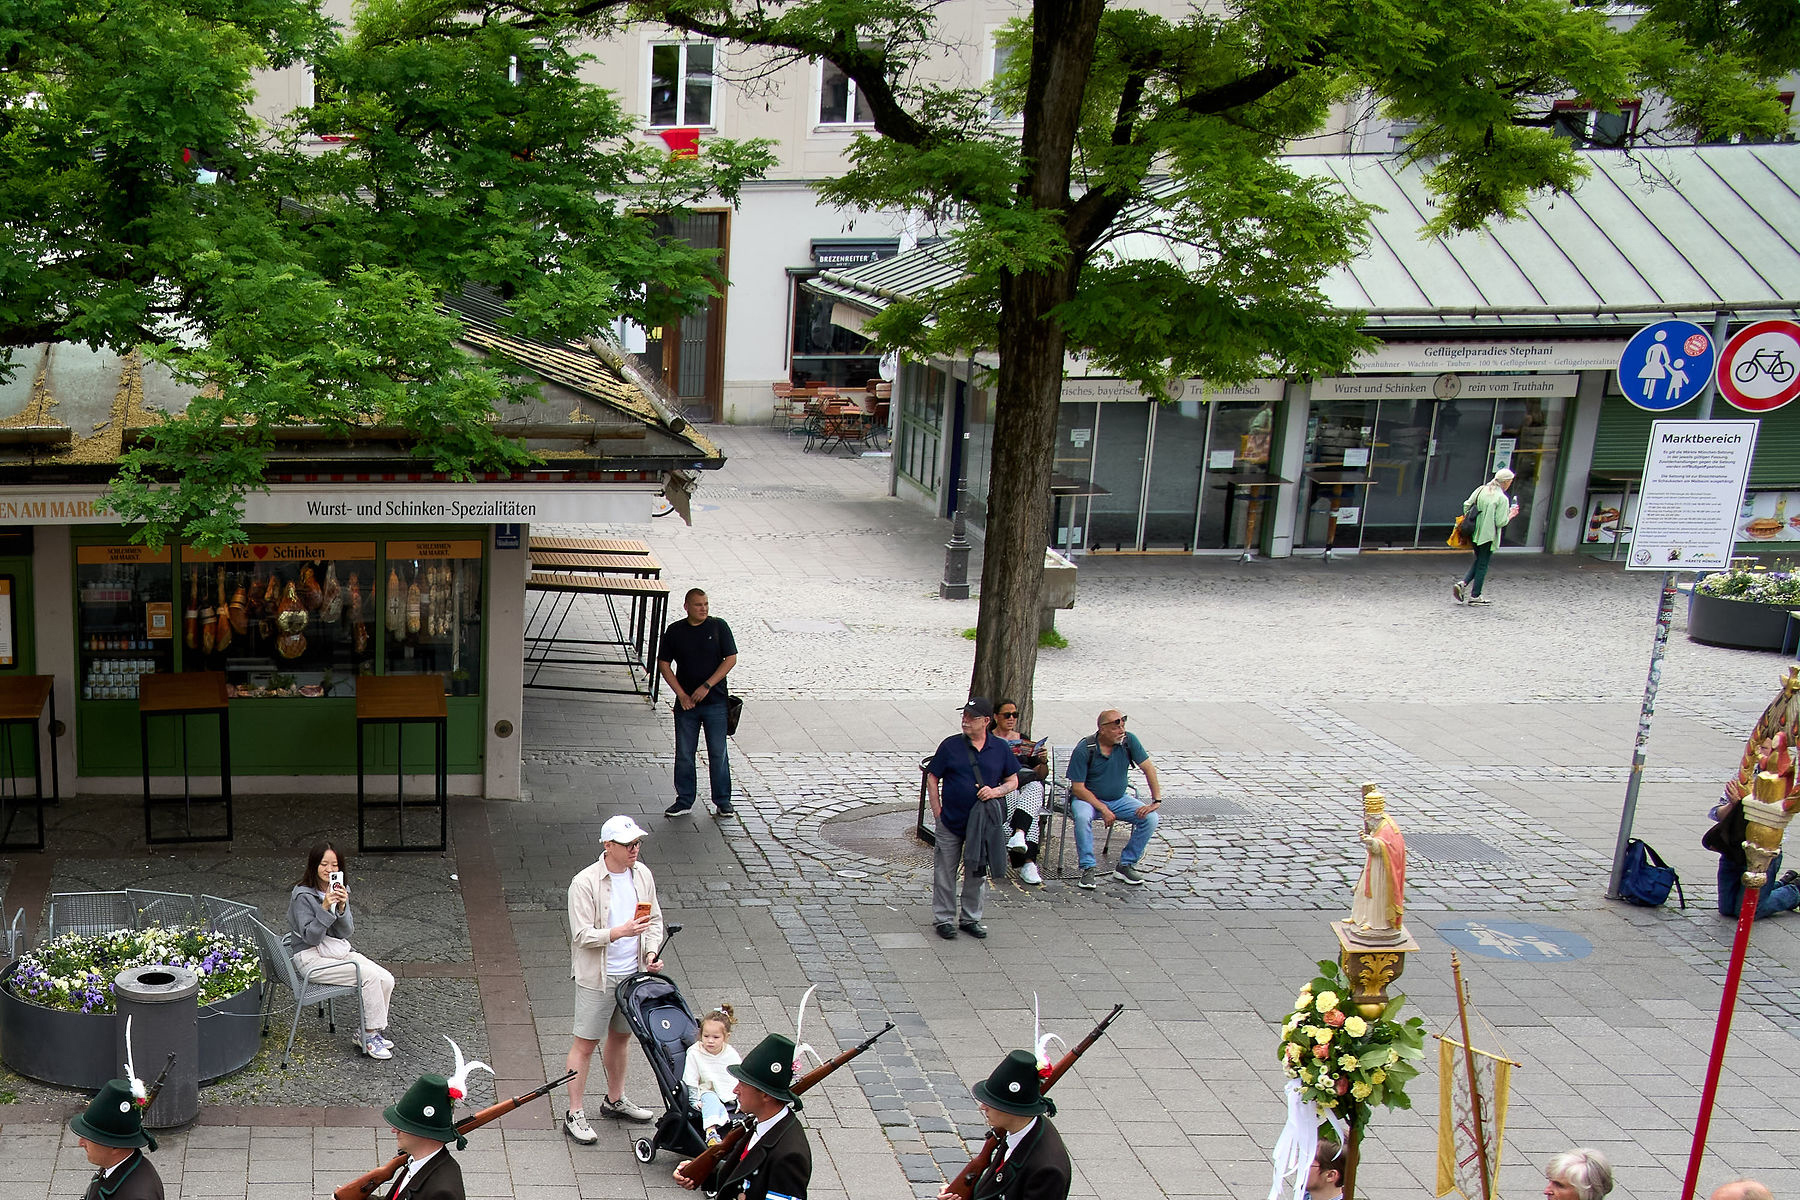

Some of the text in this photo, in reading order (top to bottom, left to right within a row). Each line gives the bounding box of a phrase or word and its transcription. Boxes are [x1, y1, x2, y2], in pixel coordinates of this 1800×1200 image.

[819, 255, 868, 263] BREZENREITER
[1424, 346, 1553, 359] Geflügelparadies Stephani
[1447, 360, 1471, 368] Tauben
[1500, 359, 1547, 368] Geflügelwurst
[1554, 358, 1619, 367] Geflügelspezialitäte
[1334, 381, 1554, 393] Wurst und Schinken rein vom Truthahn
[1661, 433, 1741, 444] Marktbereich
[21, 501, 47, 519] AM
[307, 500, 537, 519] Wurst- und Schinken-Spezialitäten
[231, 546, 326, 559] We Schinken
